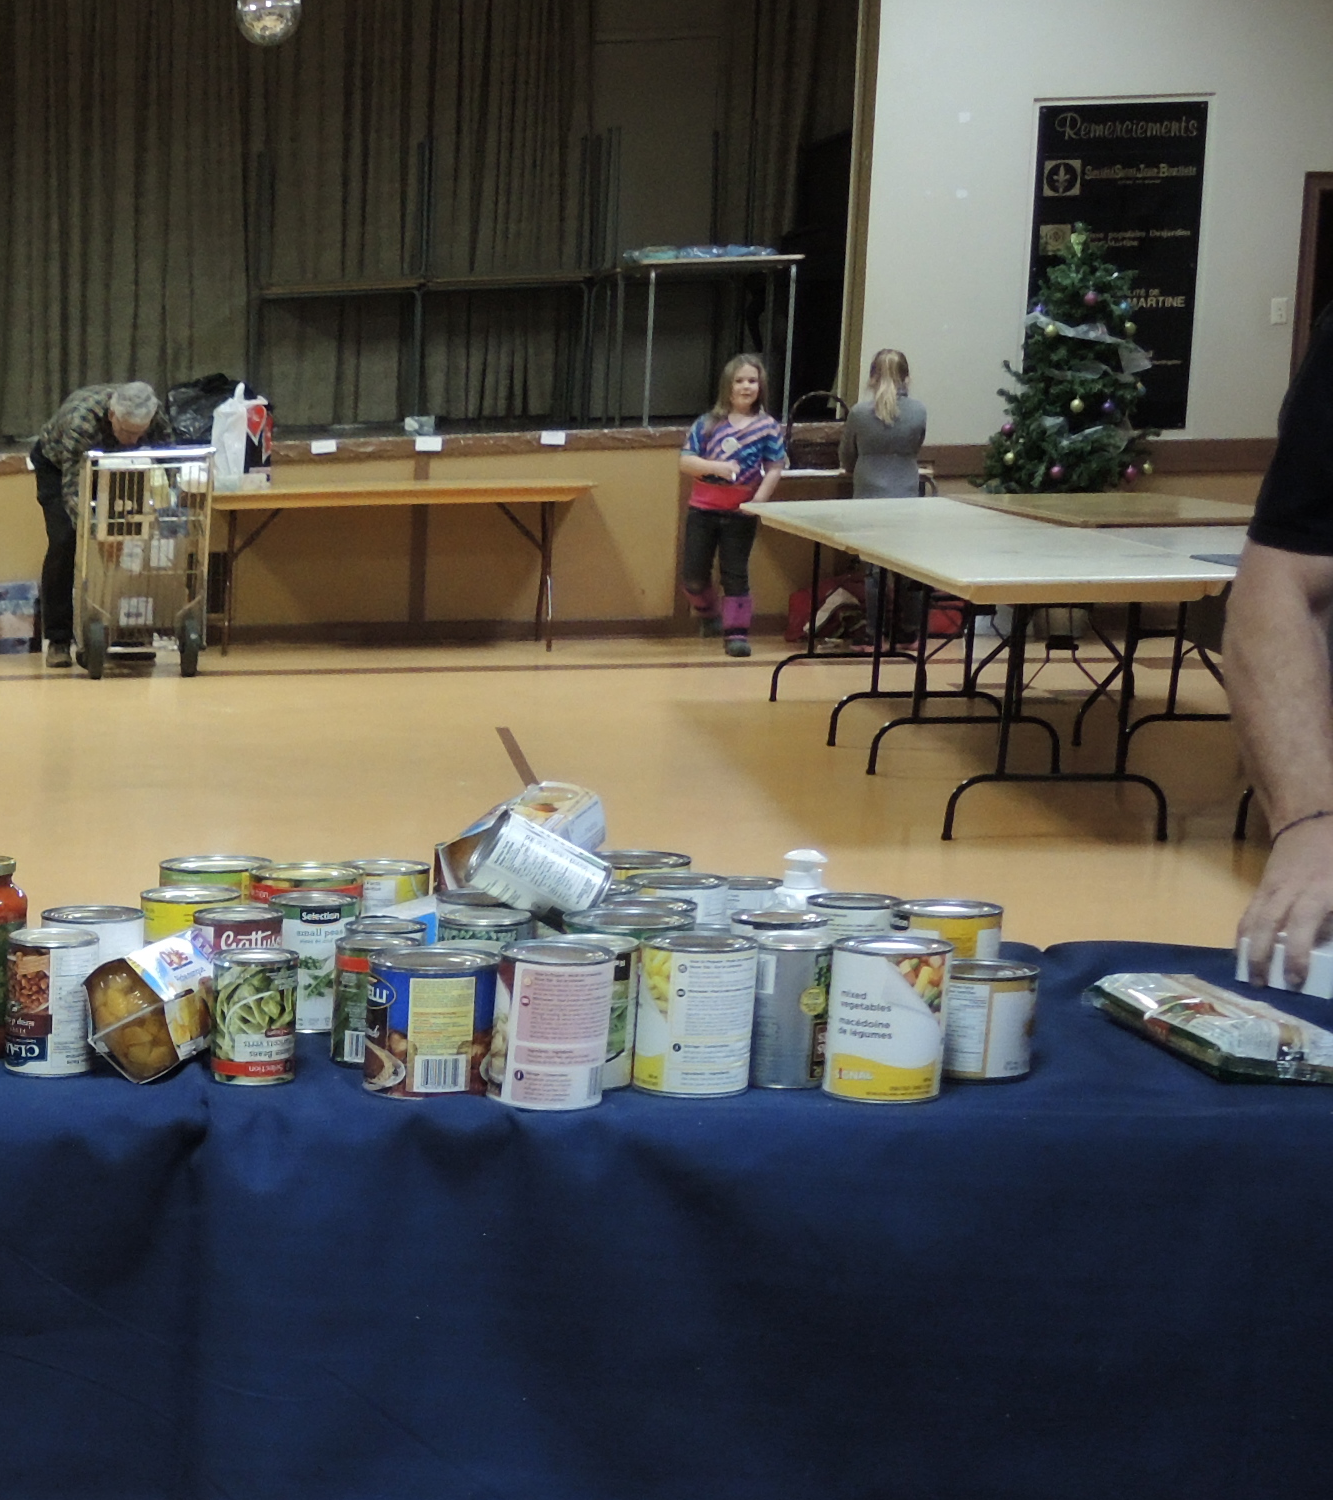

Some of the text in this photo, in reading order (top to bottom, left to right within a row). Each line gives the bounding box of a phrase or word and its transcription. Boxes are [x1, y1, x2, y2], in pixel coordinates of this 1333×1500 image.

[1055, 113, 1198, 140] Remerciements
[301, 910, 340, 921] Selection
[840, 990, 866, 999] mixed
[840, 1001, 892, 1013] vegetables
